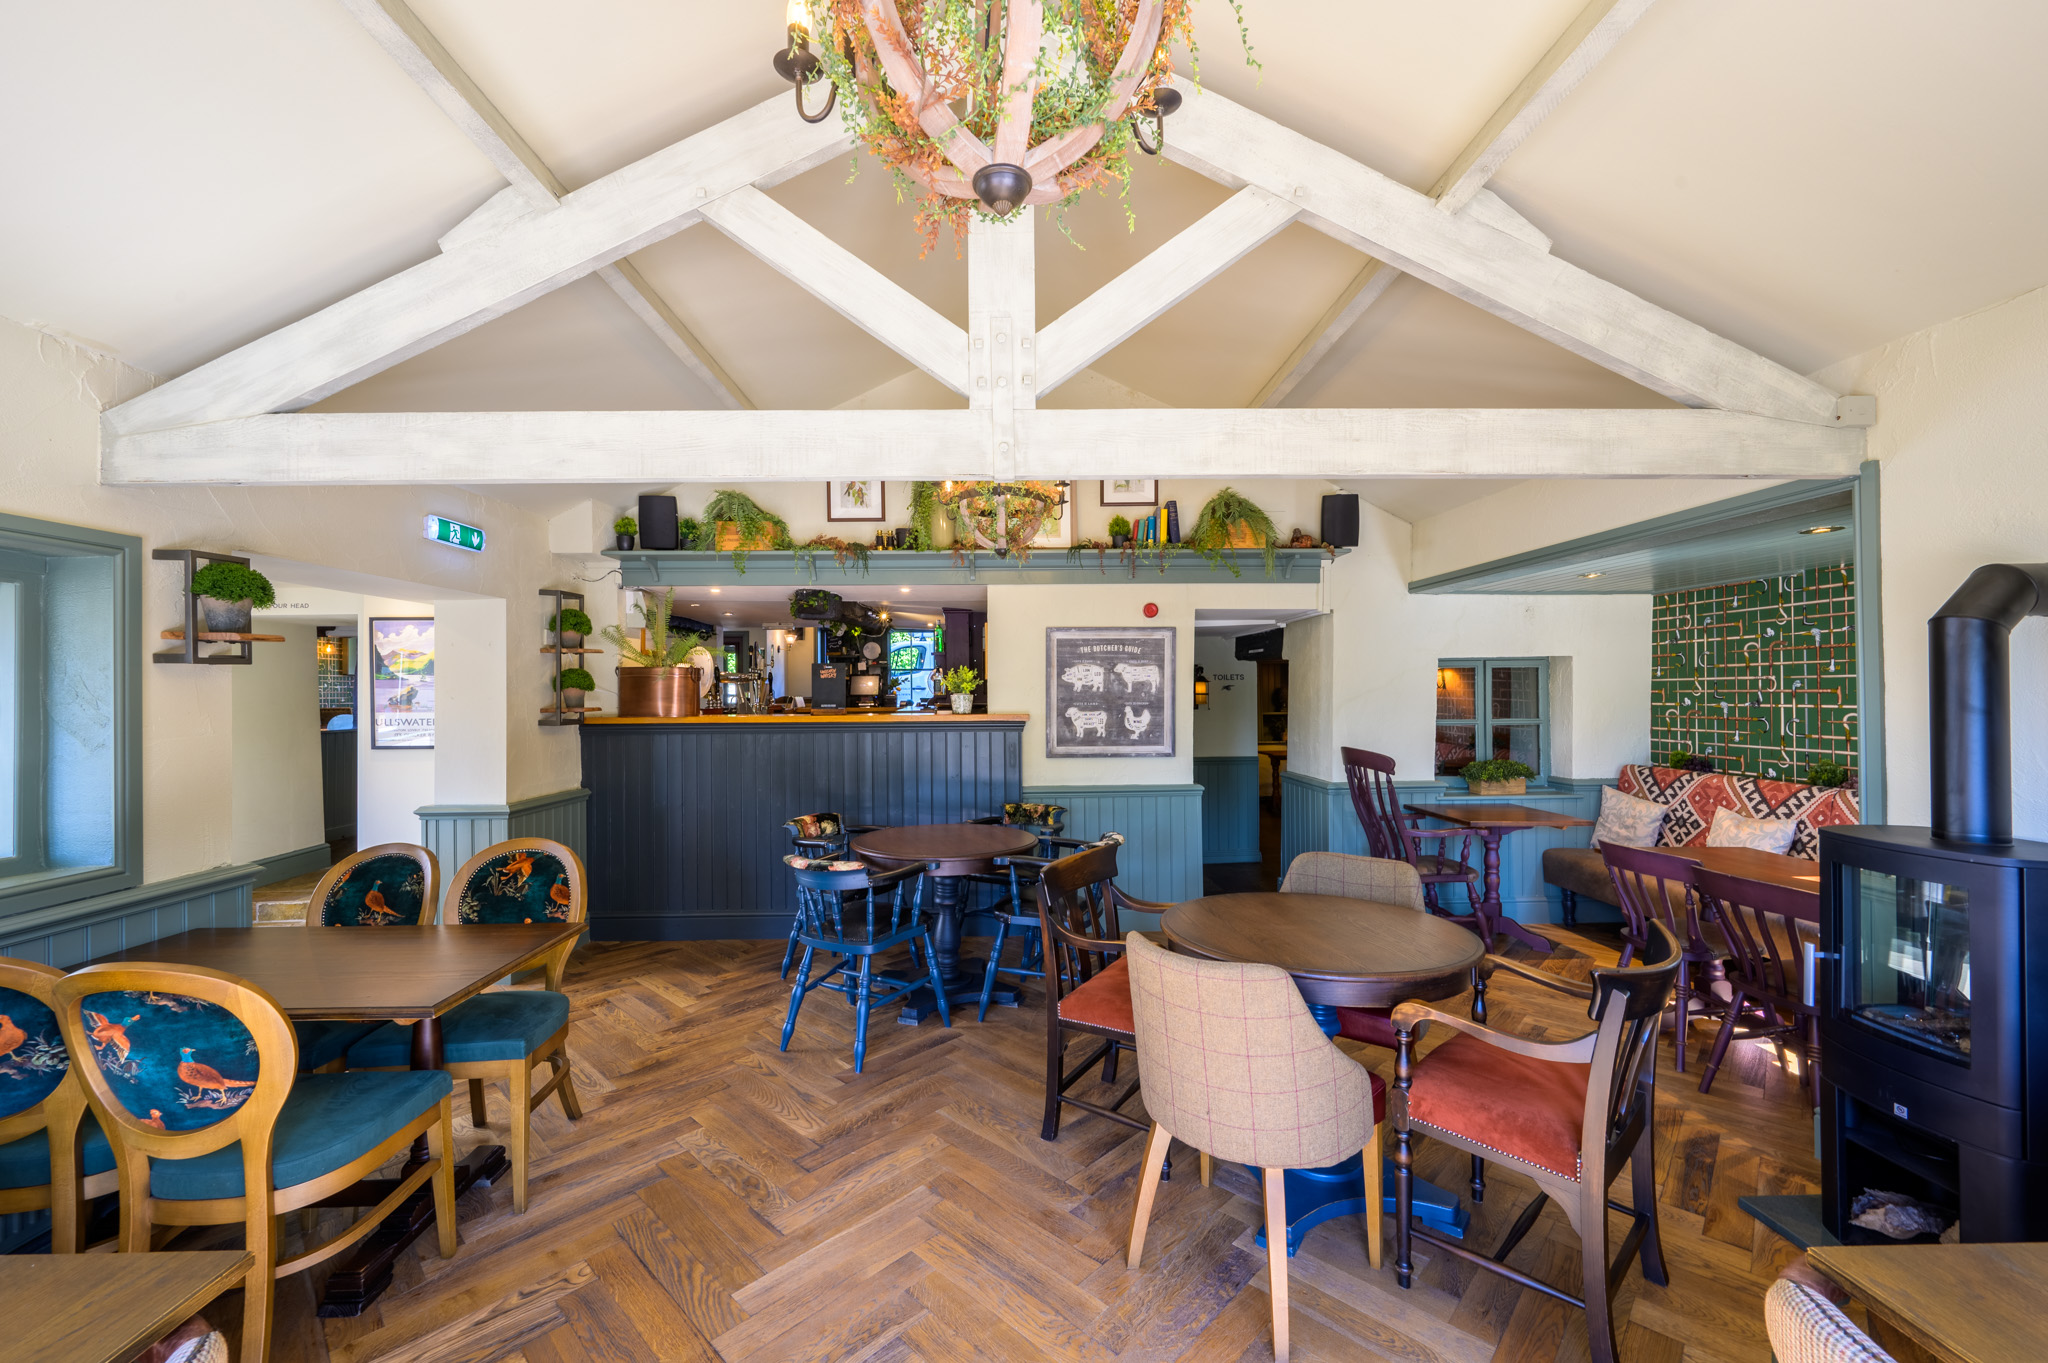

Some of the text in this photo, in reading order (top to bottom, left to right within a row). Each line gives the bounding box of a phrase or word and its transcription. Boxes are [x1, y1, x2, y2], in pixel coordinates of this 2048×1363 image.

[1080, 644, 1142, 654] THE BUTCHER'S GUIDE
[375, 718, 435, 726] ULLSWATE
